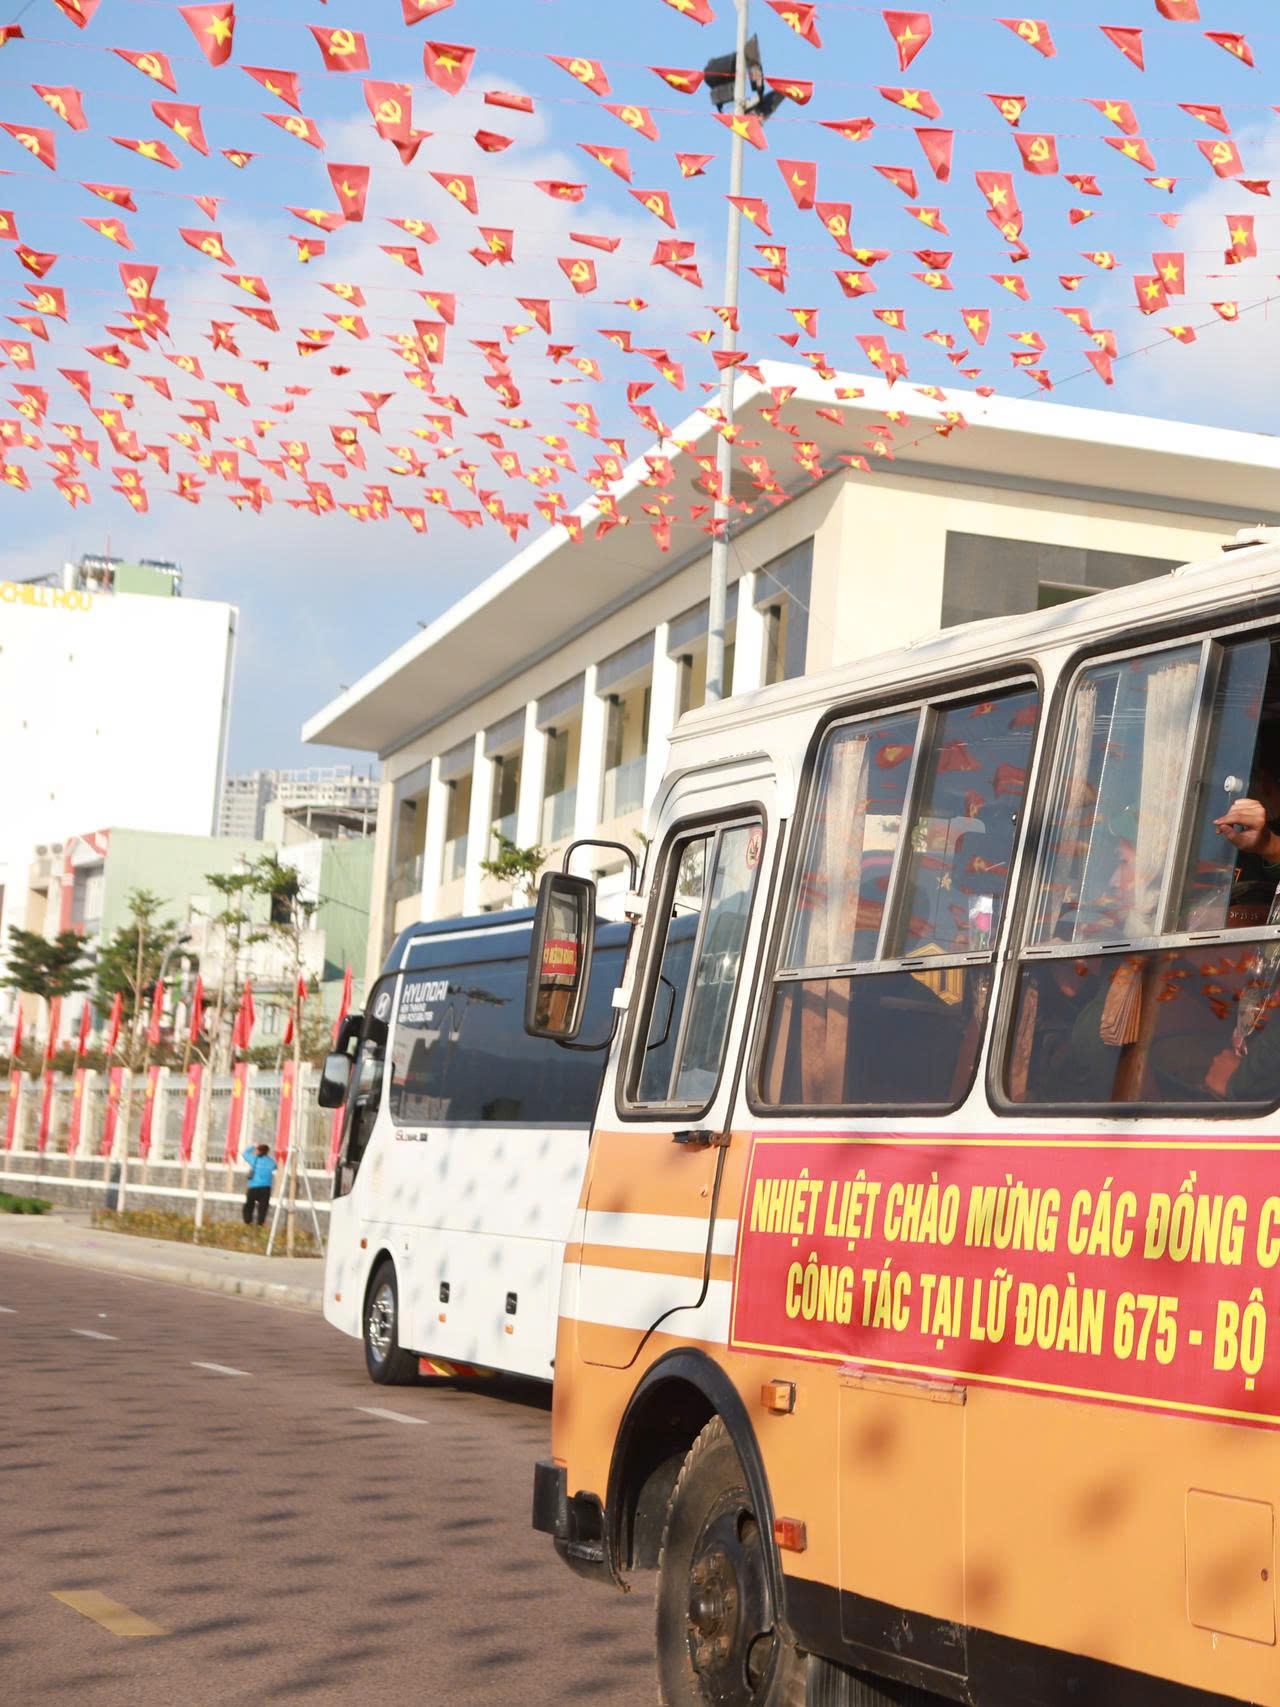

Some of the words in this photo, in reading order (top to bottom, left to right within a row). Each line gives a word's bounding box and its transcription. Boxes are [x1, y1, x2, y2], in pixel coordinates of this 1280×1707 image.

[402, 980, 449, 1003] HYUNDAI
[749, 1167, 825, 1248] NHIỆT
[823, 1168, 882, 1251] LIỆT
[883, 1171, 961, 1247] CHÀO
[964, 1173, 1061, 1253] MỪNG
[1067, 1176, 1137, 1258] CÁC
[1144, 1170, 1248, 1265] ĐỒNG
[785, 1251, 855, 1325] CÔNG
[861, 1257, 912, 1332] TÁC
[920, 1273, 965, 1351] TẠI
[969, 1267, 1013, 1344] LỮ
[1015, 1272, 1107, 1356] ĐOÀN
[1112, 1291, 1179, 1365] 675
[1188, 1329, 1203, 1345] -
[1213, 1287, 1267, 1391] BỘ
